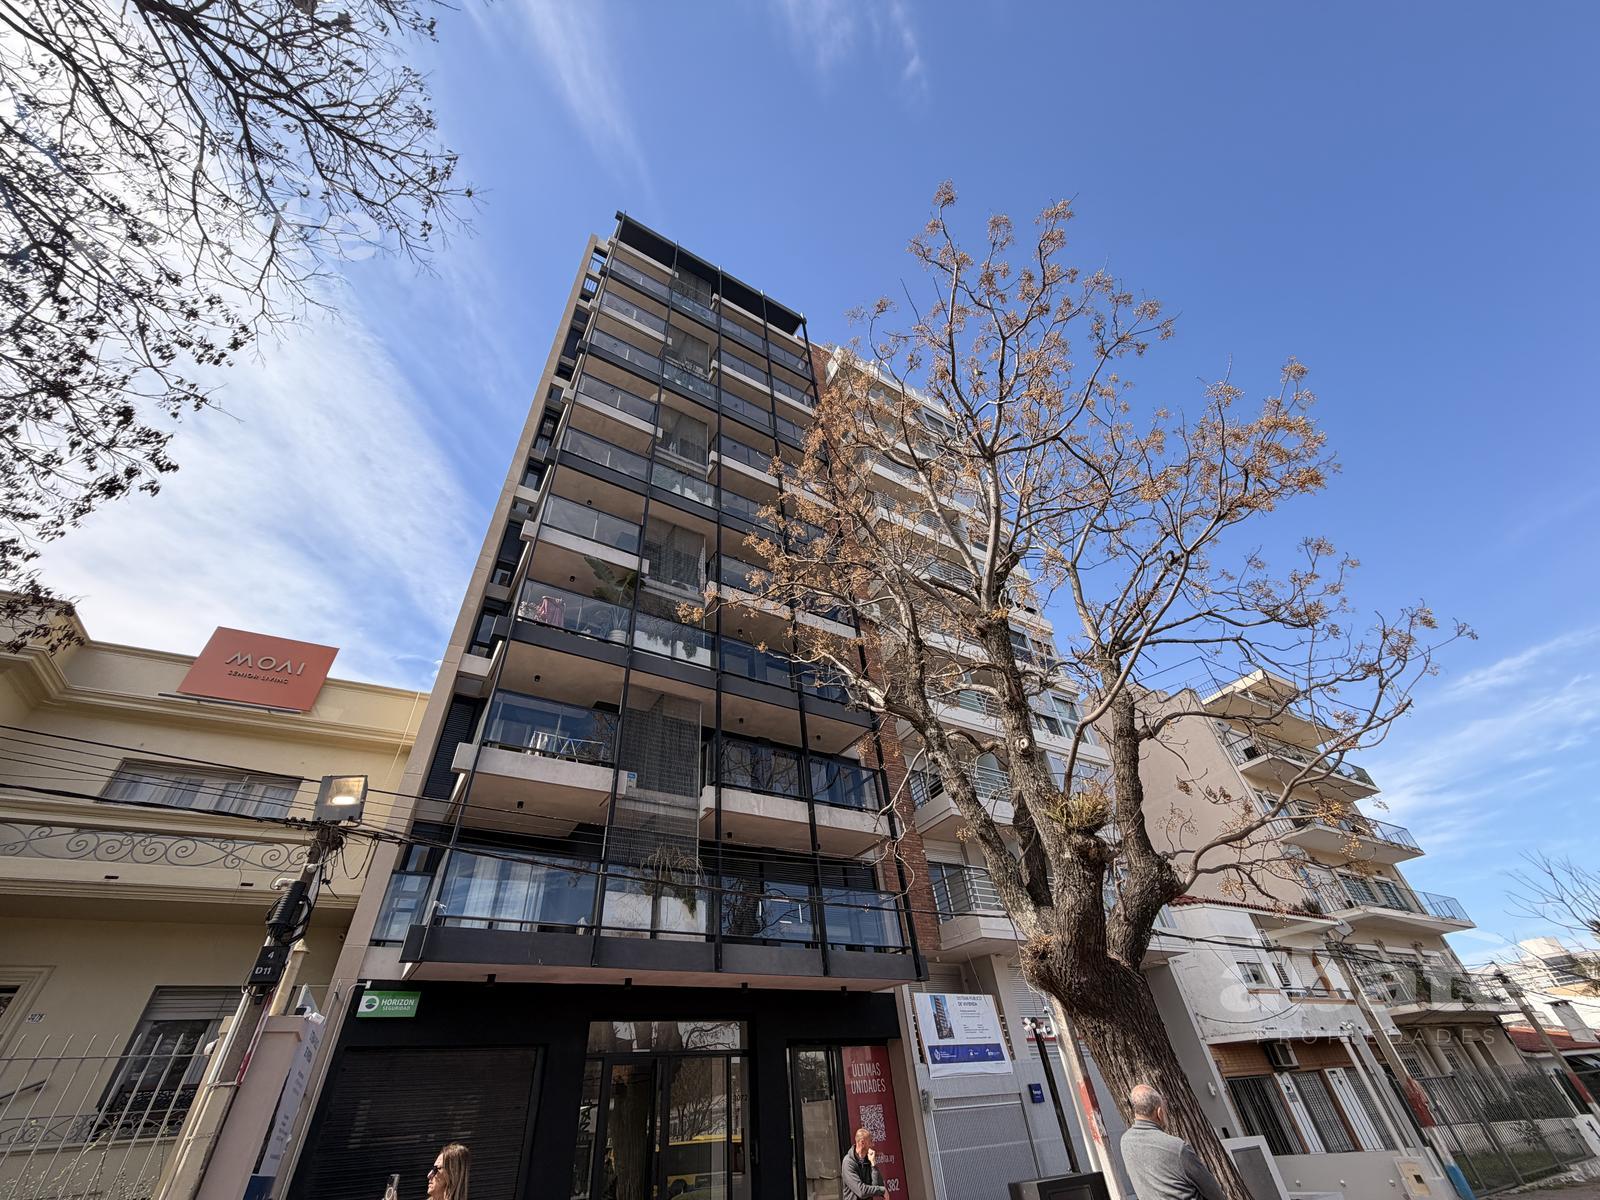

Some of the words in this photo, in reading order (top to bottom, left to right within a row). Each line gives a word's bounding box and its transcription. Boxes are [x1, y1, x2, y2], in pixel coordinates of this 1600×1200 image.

[225, 651, 306, 676] MOAI
[227, 671, 259, 680] SENIOR
[260, 676, 289, 684] LIVING
[267, 951, 275, 960] 4
[255, 966, 272, 975] D11
[381, 998, 415, 1006] HORIZON
[851, 1060, 881, 1078] ÚLTIMAS
[850, 1078, 887, 1095] UNIDADES
